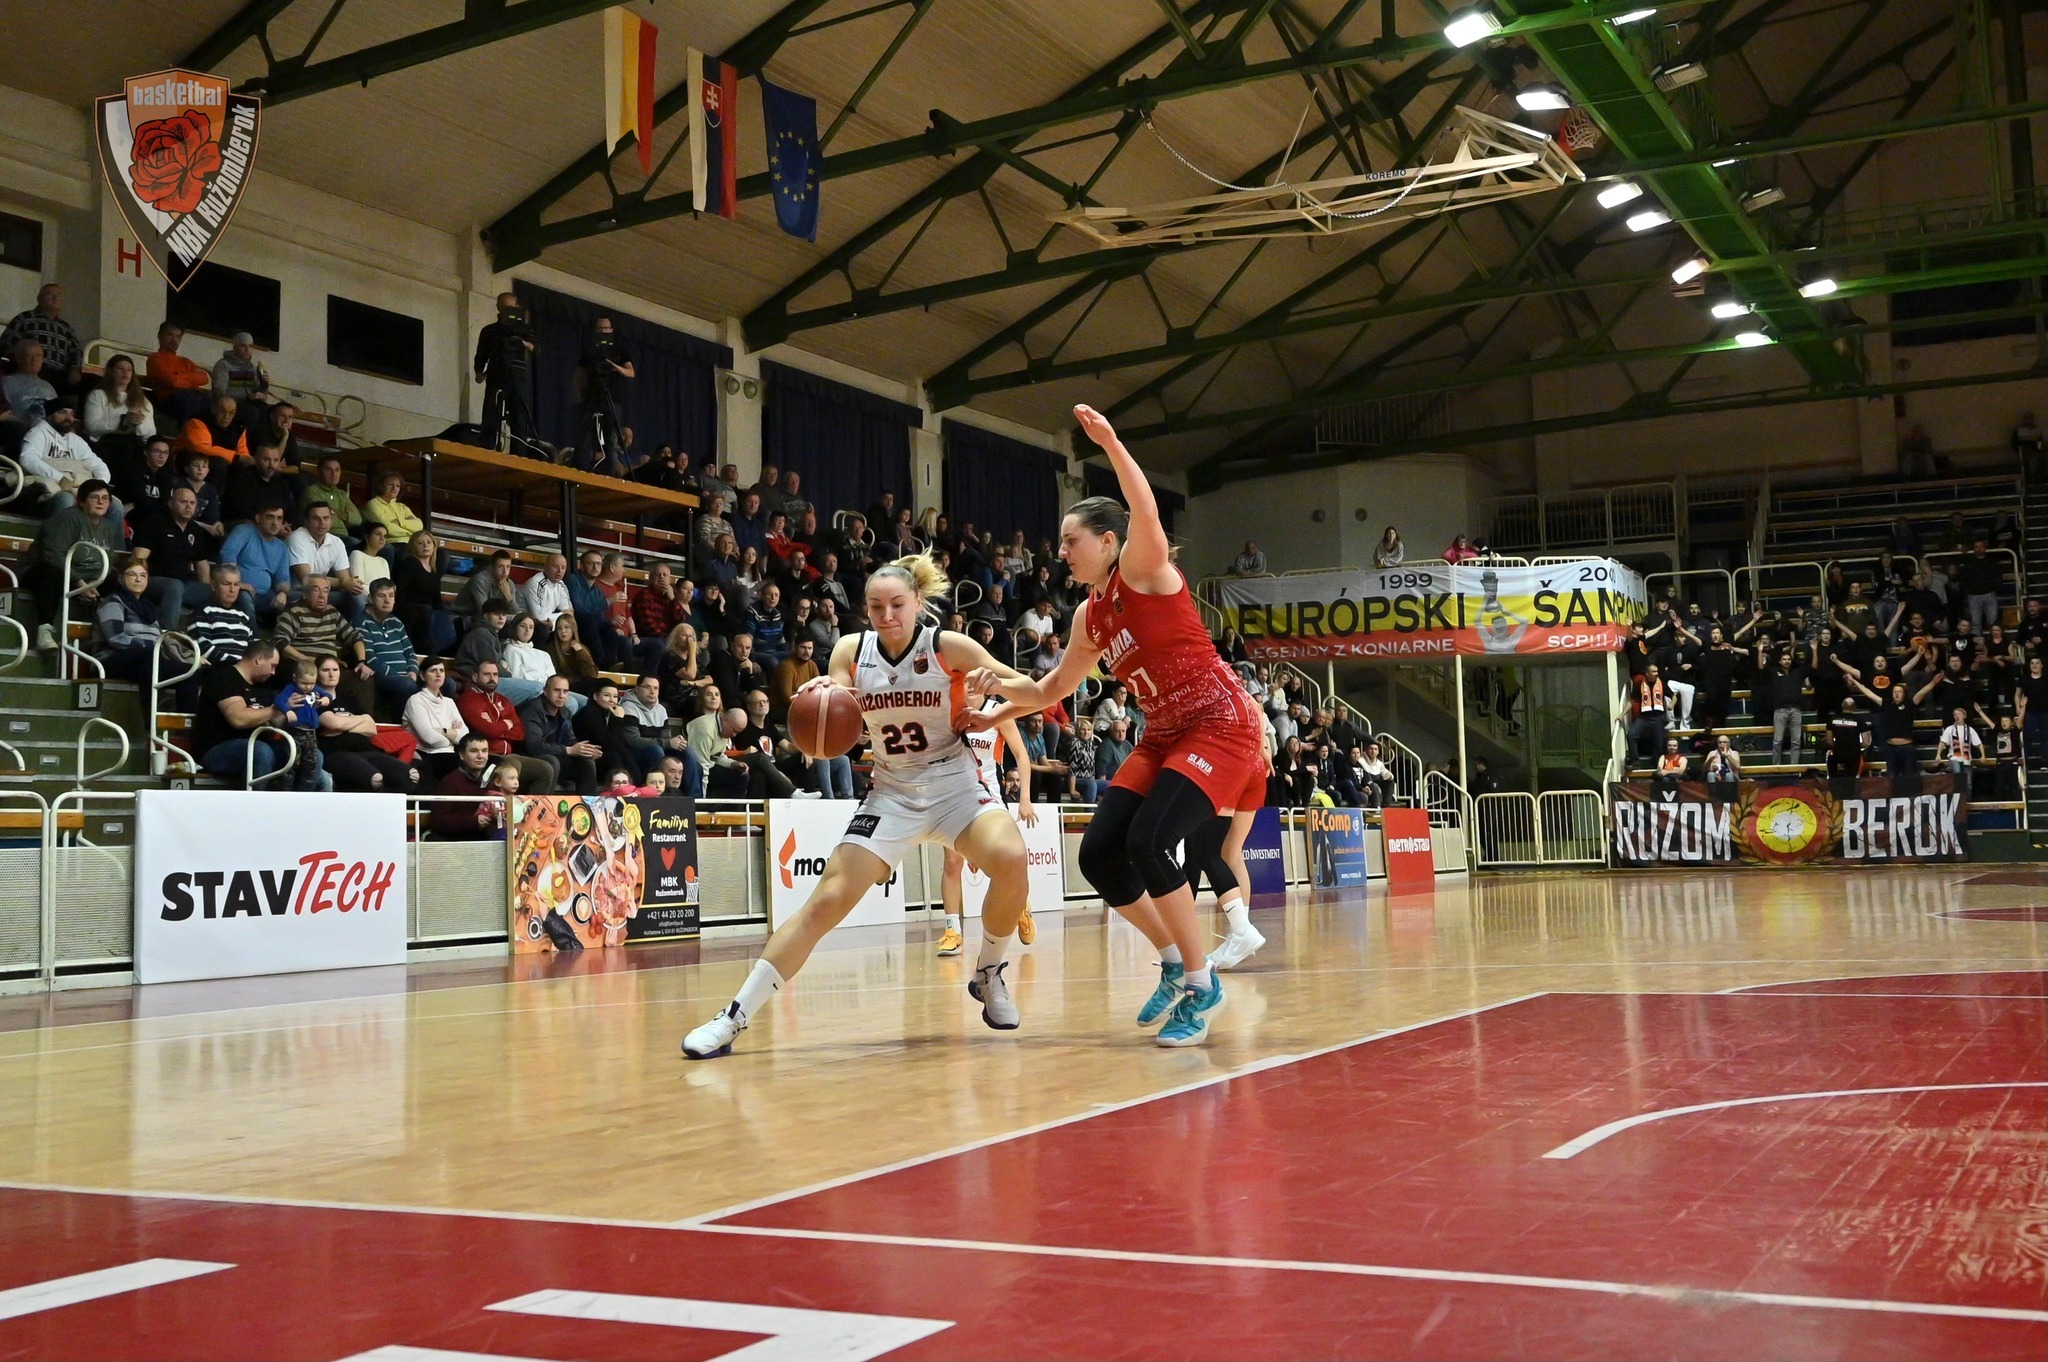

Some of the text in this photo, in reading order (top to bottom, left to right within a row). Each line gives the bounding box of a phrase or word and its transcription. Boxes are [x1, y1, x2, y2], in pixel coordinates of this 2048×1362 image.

[1365, 169, 1407, 181] KOREMO
[117, 237, 142, 278] H
[1379, 573, 1433, 590] 1999
[1237, 587, 1466, 640] EURÓPSKI
[1333, 644, 1347, 656] Z
[1351, 638, 1455, 656] KONIARNE
[1547, 633, 1608, 648] SCP!!!
[83, 686, 92, 704] 3
[856, 690, 942, 712] UŽOMBEROK
[881, 721, 929, 756] 23
[969, 738, 992, 751] EROK
[649, 809, 689, 832] Familiya
[1312, 809, 1352, 838] R-Comp
[1614, 790, 1964, 861] RUŽOM BEROK
[652, 833, 687, 843] Restaurant
[1027, 848, 1058, 866] berok
[660, 876, 679, 888] MBK
[647, 908, 695, 919] +421 44 20 20 200
